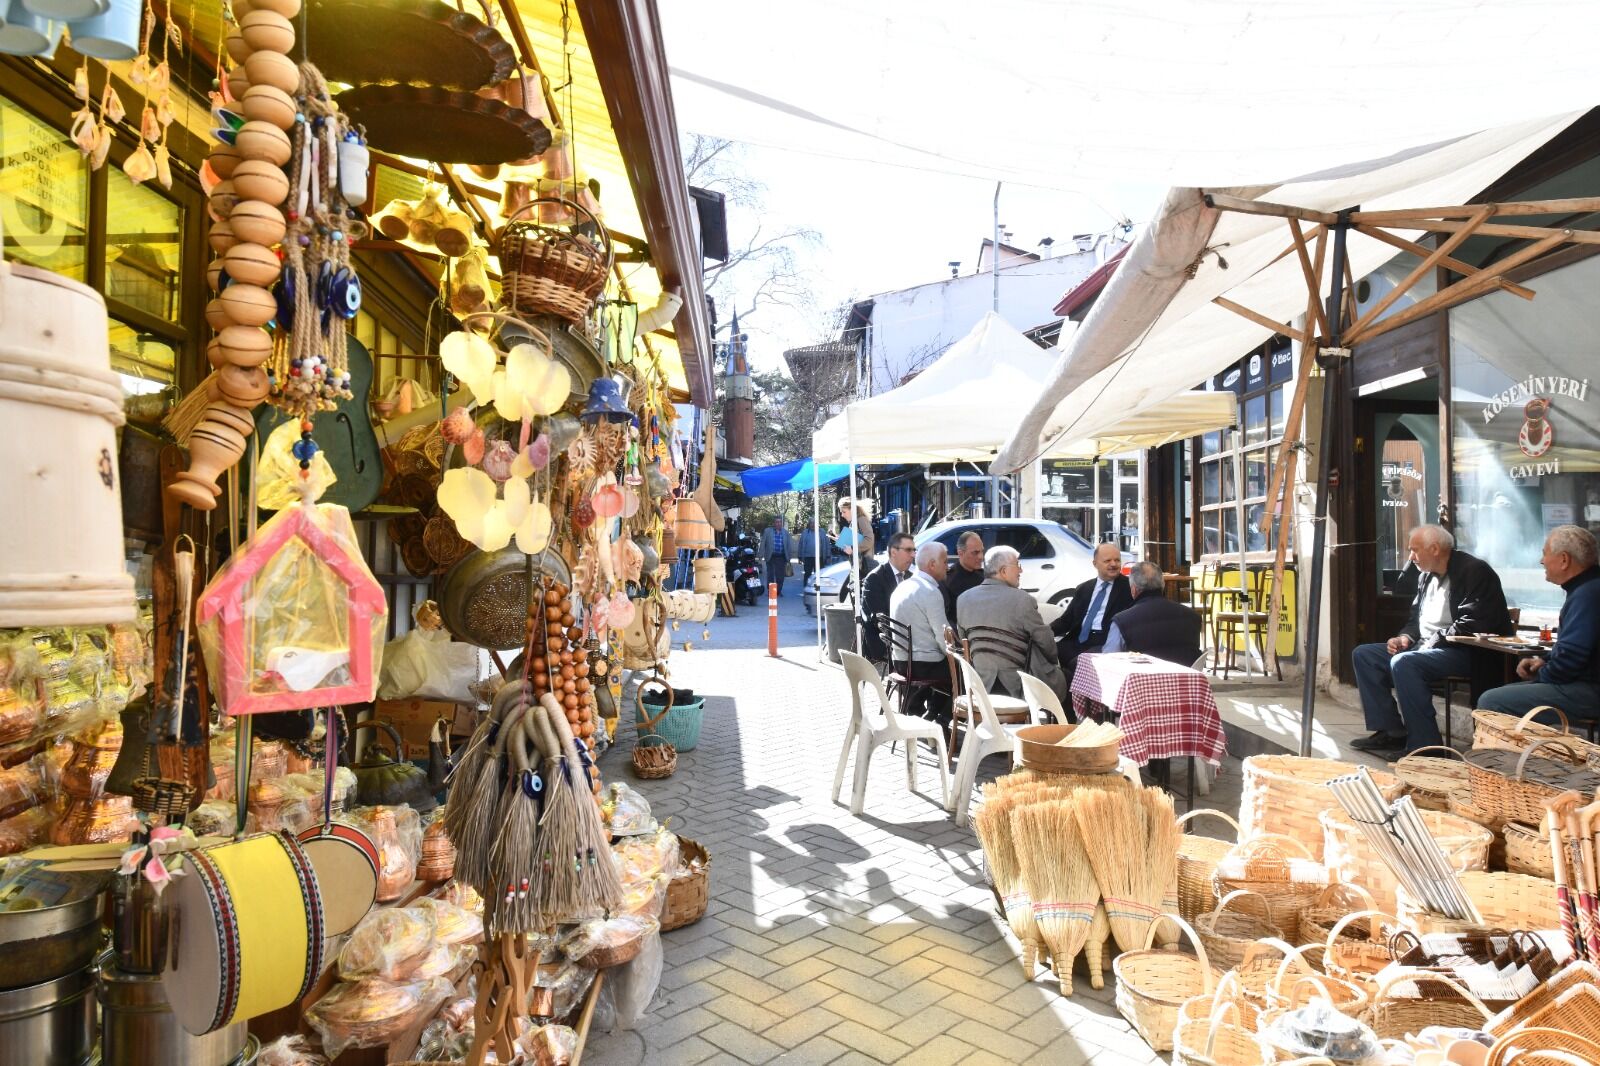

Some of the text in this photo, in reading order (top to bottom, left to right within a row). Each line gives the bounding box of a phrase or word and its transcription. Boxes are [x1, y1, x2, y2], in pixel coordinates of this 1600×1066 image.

[1548, 376, 1588, 402] YERİ
[1509, 458, 1560, 483] ÇAY EVİ
